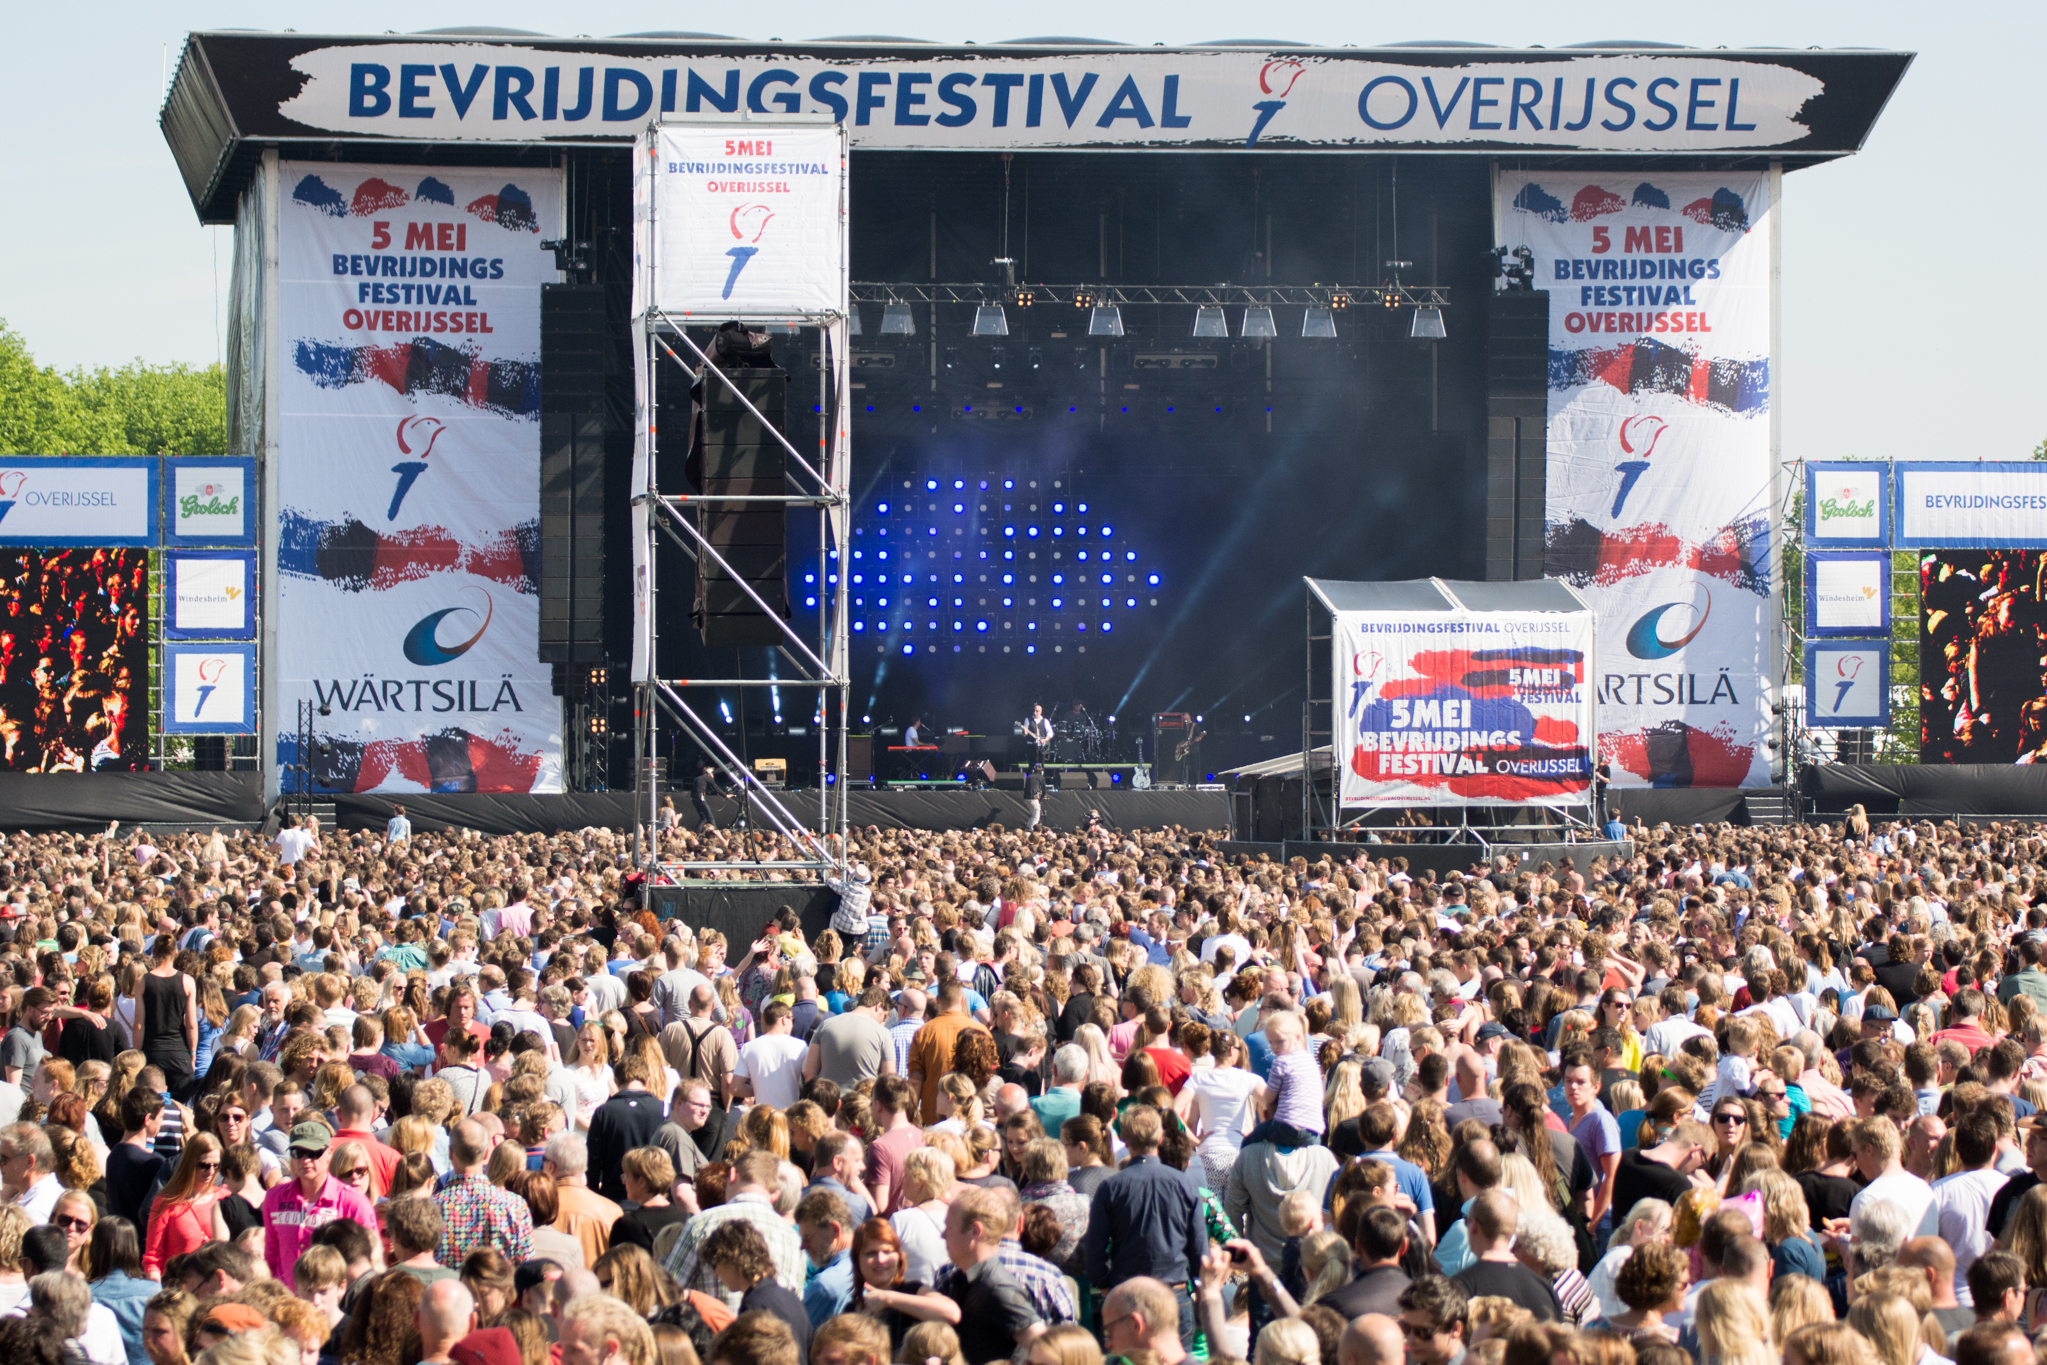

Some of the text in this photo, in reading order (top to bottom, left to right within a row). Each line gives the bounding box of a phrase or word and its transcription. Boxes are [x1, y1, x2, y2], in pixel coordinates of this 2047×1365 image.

[348, 62, 1757, 132] BEVRIJDINGSFESTIVAL OVERIJSSEL
[668, 162, 829, 175] BEVRIJDINGSFESTIVAL
[706, 181, 791, 193] OVERIJSSEL
[371, 221, 466, 251] 5 MEI
[1591, 226, 1683, 254] 5 MEI
[332, 254, 504, 279] BEVRIJDINGS
[1554, 258, 1721, 280] BEVRIJDINGS
[358, 282, 477, 306] FESTIVAL
[1581, 285, 1696, 306] FESTIVAL
[342, 308, 494, 334] OVERIJSSEL
[1564, 311, 1712, 334] OVERIJSSEL
[25, 491, 117, 506] OVERIJSSEL
[179, 494, 240, 519] Grolsch
[1819, 497, 1875, 521] Grolsch
[1925, 494, 2047, 510] BEVRIJDINGSFES
[178, 595, 228, 603] Windesheim
[1818, 594, 1865, 602] Windesheim
[1361, 622, 1571, 634] BEVRIJDINGSFESTIVAL OVERIJSSEL
[313, 673, 524, 713] WÄRTSILÄ
[1596, 667, 1740, 705] RTSILÄ
[1519, 691, 1582, 704] FESTIVAL
[1362, 730, 1522, 752] BEVRIJDINGS
[1379, 753, 1584, 774] FESTIVAL OVERIJSSEL
